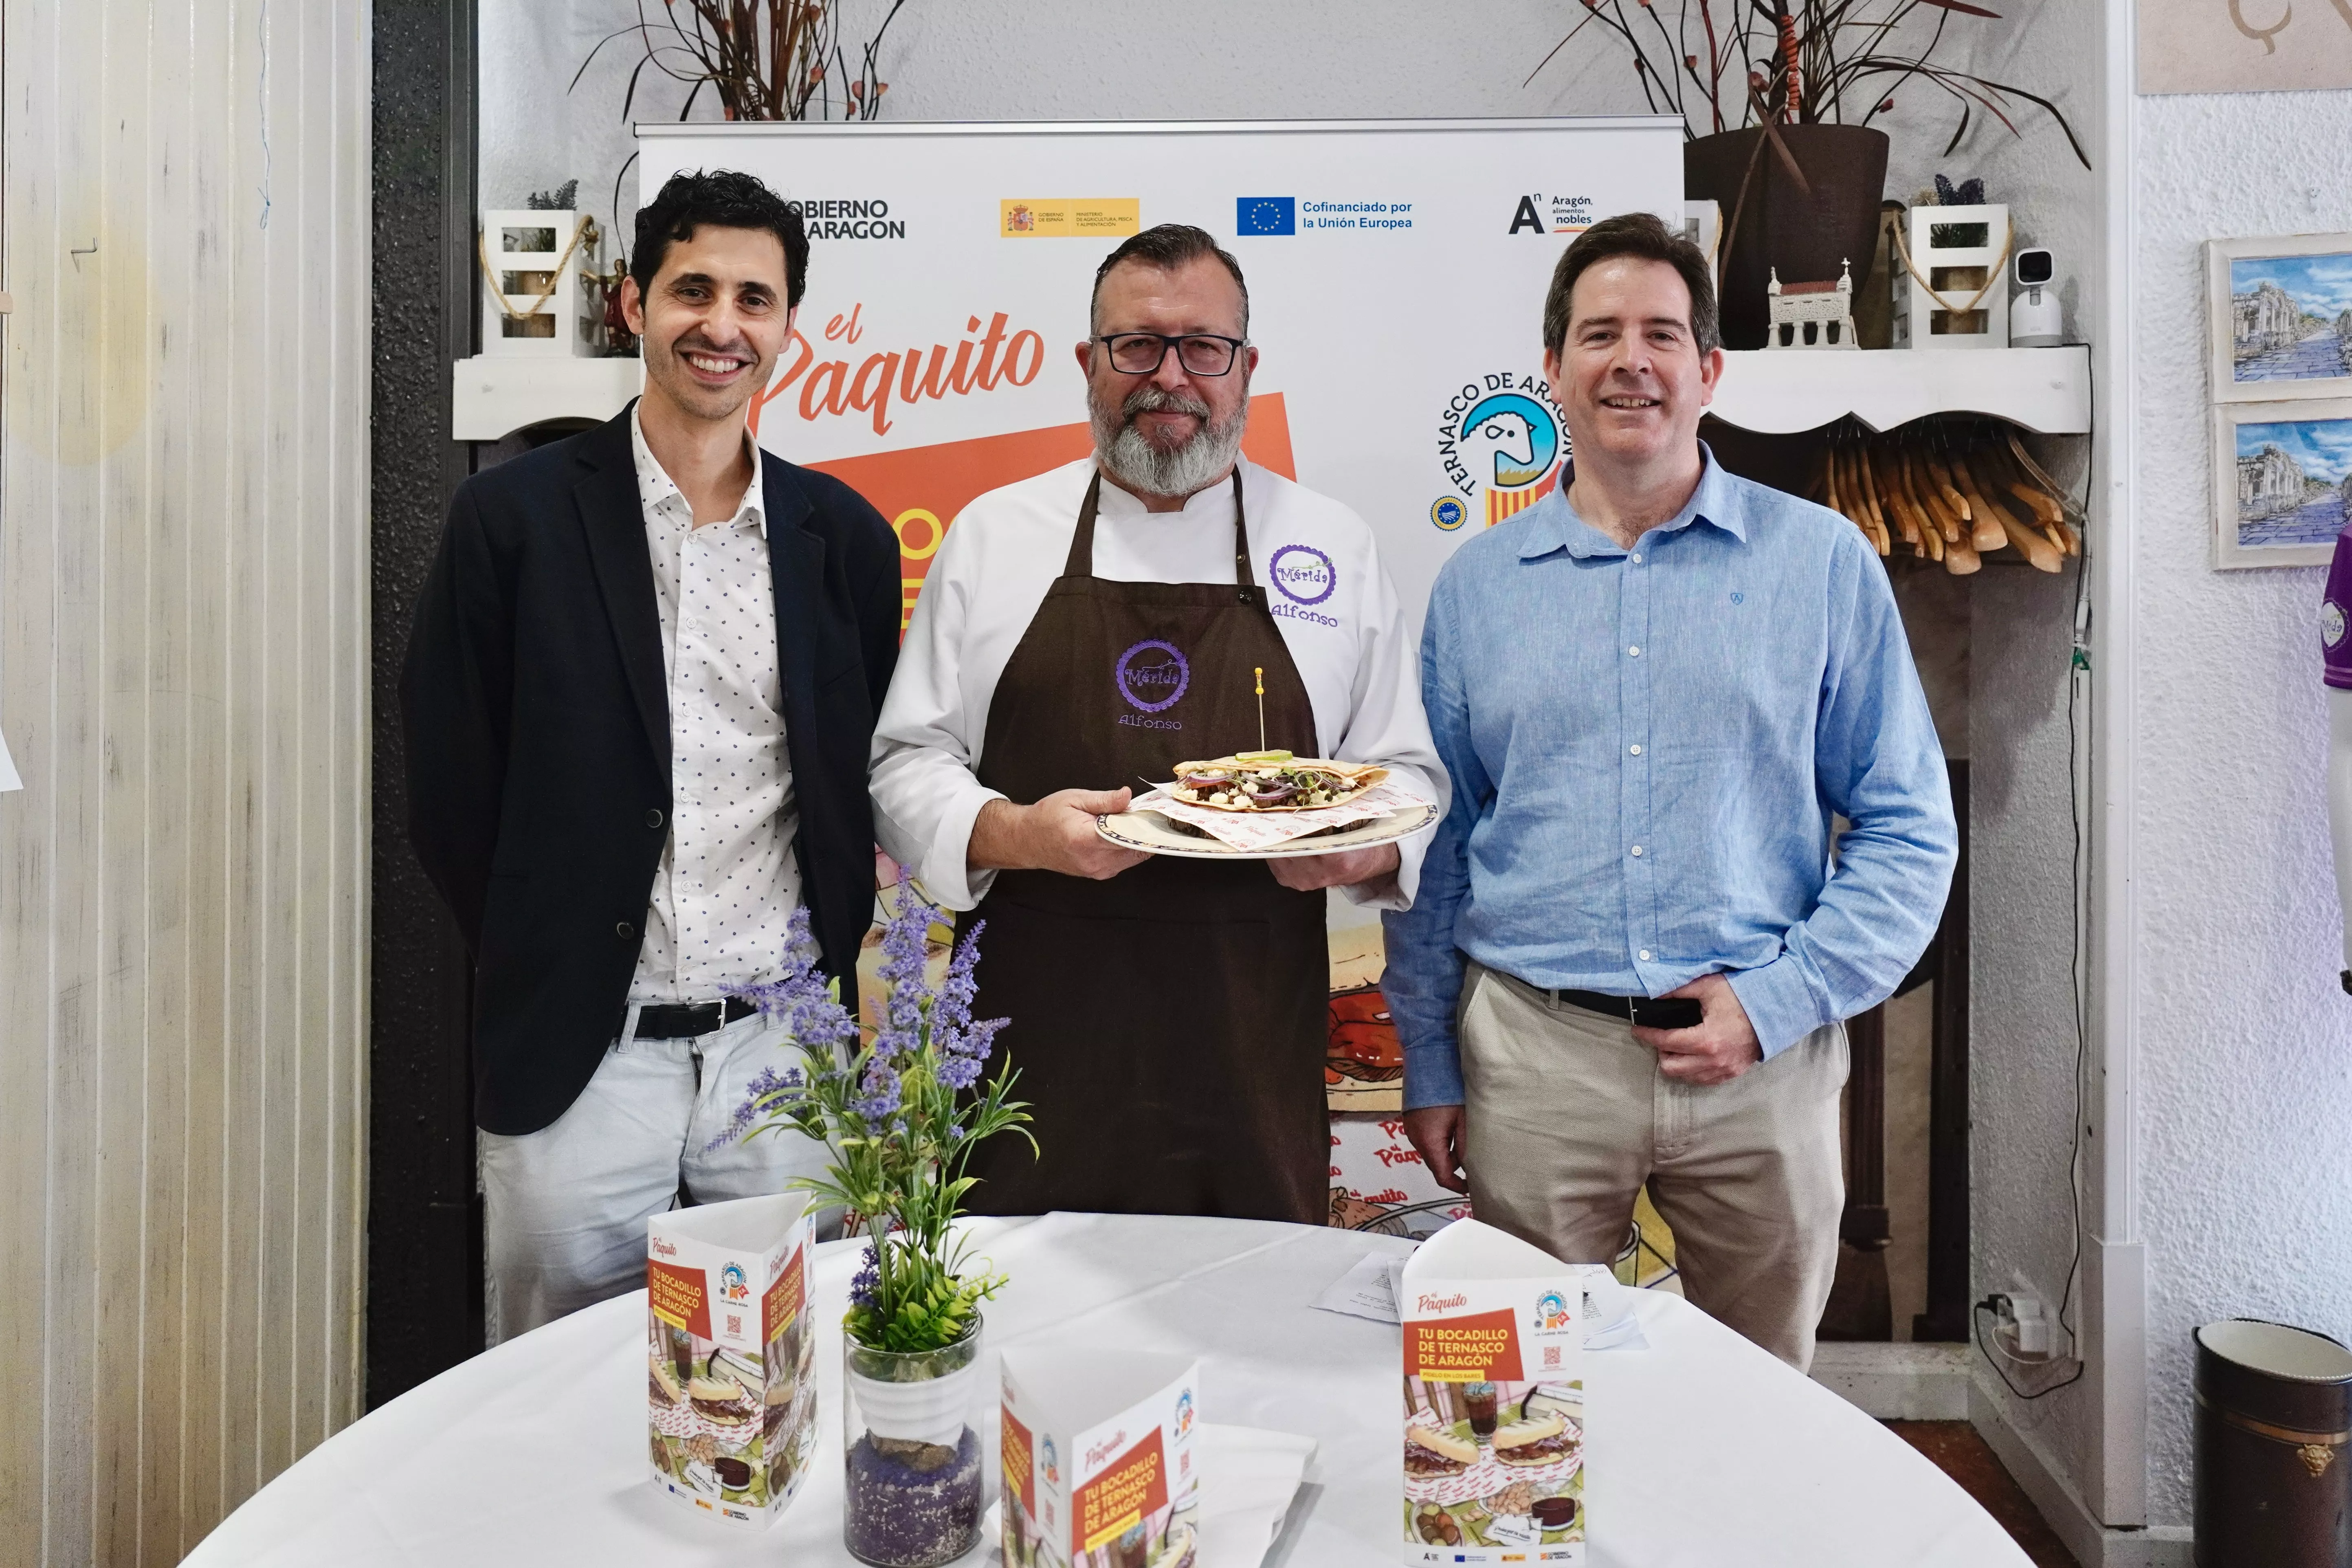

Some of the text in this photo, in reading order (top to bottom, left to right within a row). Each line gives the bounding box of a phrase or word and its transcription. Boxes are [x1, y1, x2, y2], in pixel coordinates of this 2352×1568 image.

[787, 200, 888, 218] OBIERNO
[1303, 202, 1412, 214] Cofinanciado por
[1552, 196, 1593, 207] Aragón,
[1303, 218, 1412, 230] la Unión Europea
[1556, 214, 1592, 224] nobles
[807, 221, 905, 239] ARAGON
[825, 303, 863, 345] el
[745, 312, 1045, 440] Paquito
[1438, 384, 1479, 497] TERNASCO
[1484, 372, 1513, 391] DE
[1277, 568, 1328, 583] Mérida
[1271, 604, 1338, 627] Alfonso
[1124, 669, 1179, 686] Mérida
[1118, 714, 1182, 730] Alfonso
[653, 1237, 677, 1258] Paquito
[653, 1267, 701, 1297] TU BOCADILLO
[770, 1291, 778, 1304] TU
[778, 1262, 802, 1295] BOCADILLO
[653, 1279, 699, 1308] DE TERNASCO
[770, 1301, 778, 1316] DE
[778, 1276, 801, 1308] TERNASCO
[1418, 1293, 1467, 1313] Paquito
[653, 1290, 692, 1318] DE ARAGÓN
[770, 1313, 778, 1328] DE
[1418, 1328, 1508, 1340] TU BOCADILLO
[1418, 1341, 1505, 1353] DE TERNASCO
[1418, 1353, 1493, 1366] DE ARAGÓN
[1084, 1484, 1099, 1502] TU
[1100, 1451, 1158, 1495] BOCADILLO
[1084, 1468, 1156, 1519] DE TERNASCO
[1084, 1514, 1100, 1534] DE
